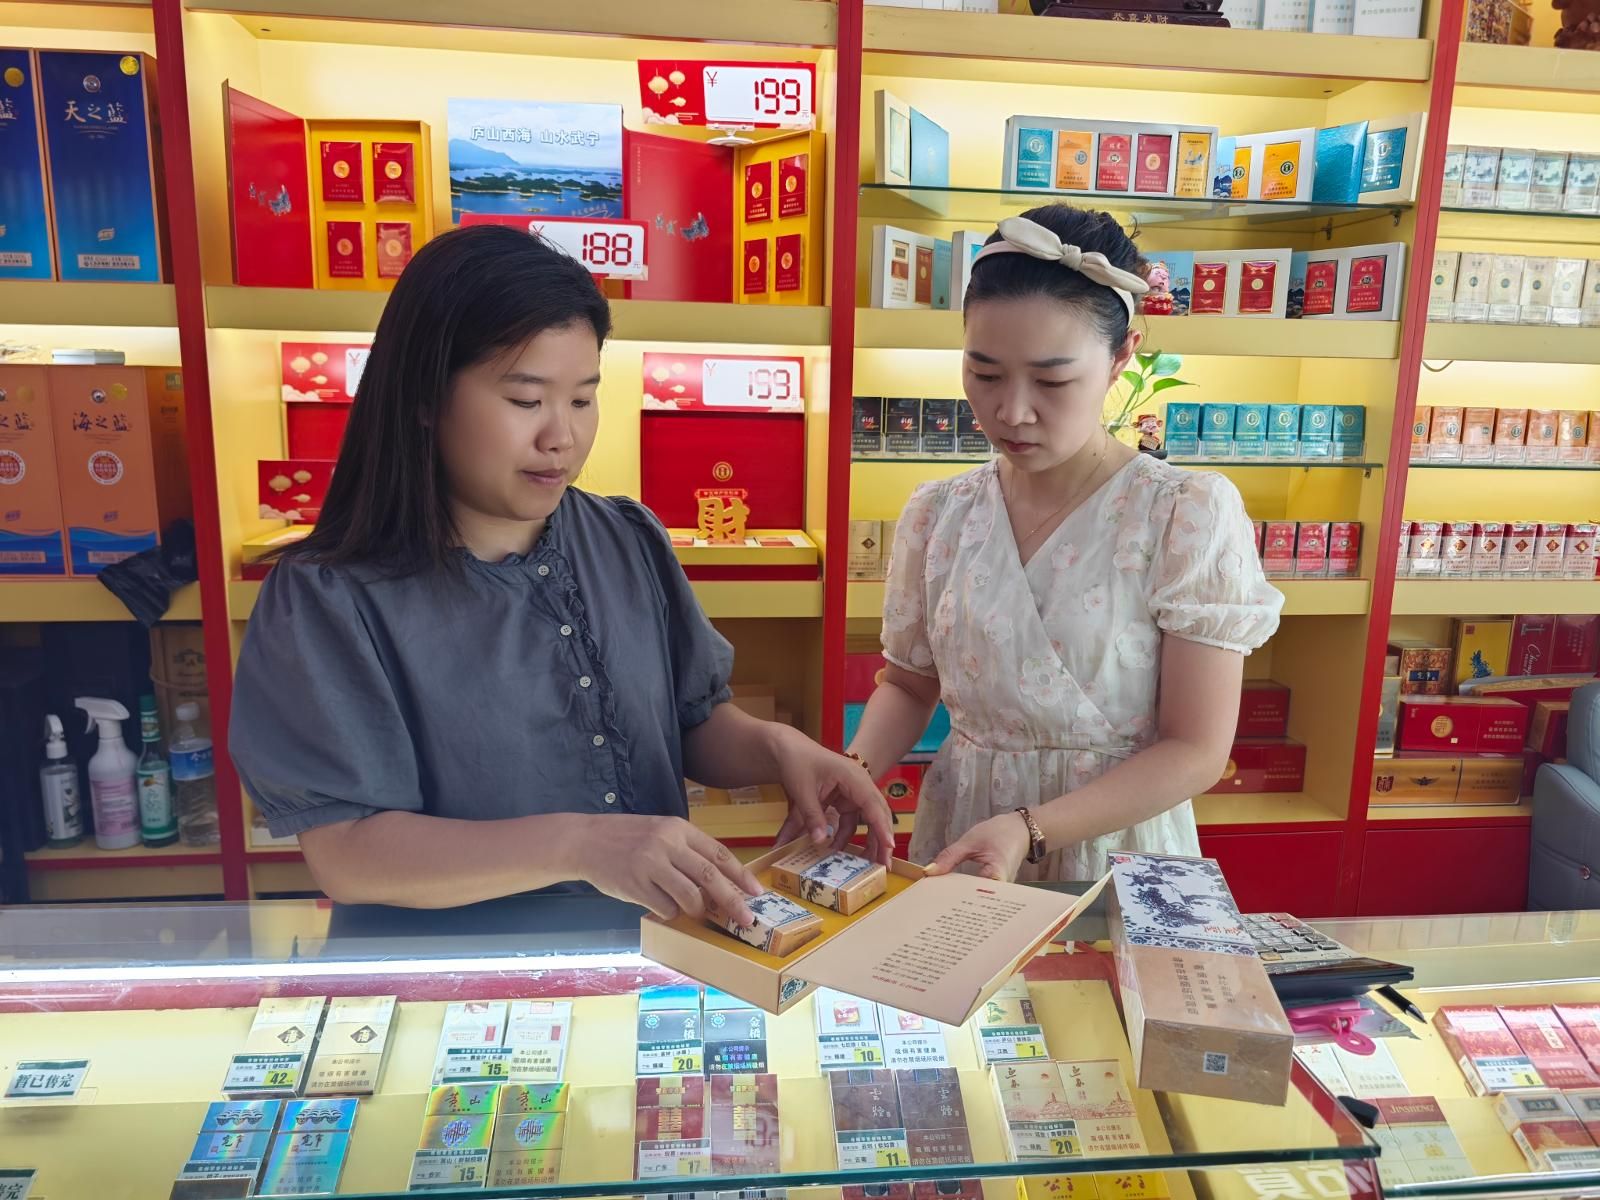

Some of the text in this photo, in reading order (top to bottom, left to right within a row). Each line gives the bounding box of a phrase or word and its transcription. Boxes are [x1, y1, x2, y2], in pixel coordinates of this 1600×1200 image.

[754, 78, 801, 115] 199
[471, 125, 600, 146] 庐山西海 山水武宁
[582, 232, 632, 267] 188
[714, 1053, 758, 1062] 吸烟有害健康
[861, 1050, 874, 1062] 10
[1029, 1045, 1036, 1056] 7
[488, 1063, 502, 1076] 15
[678, 1058, 693, 1071] 20
[15, 1073, 74, 1089] 暂已售完
[269, 1072, 288, 1085] 42
[311, 1079, 371, 1088] 请勿在禁烟场所吸烟
[1055, 1140, 1074, 1155] 20
[886, 1152, 899, 1166] 11
[459, 1166, 475, 1181] 15
[687, 1160, 701, 1174] 17
